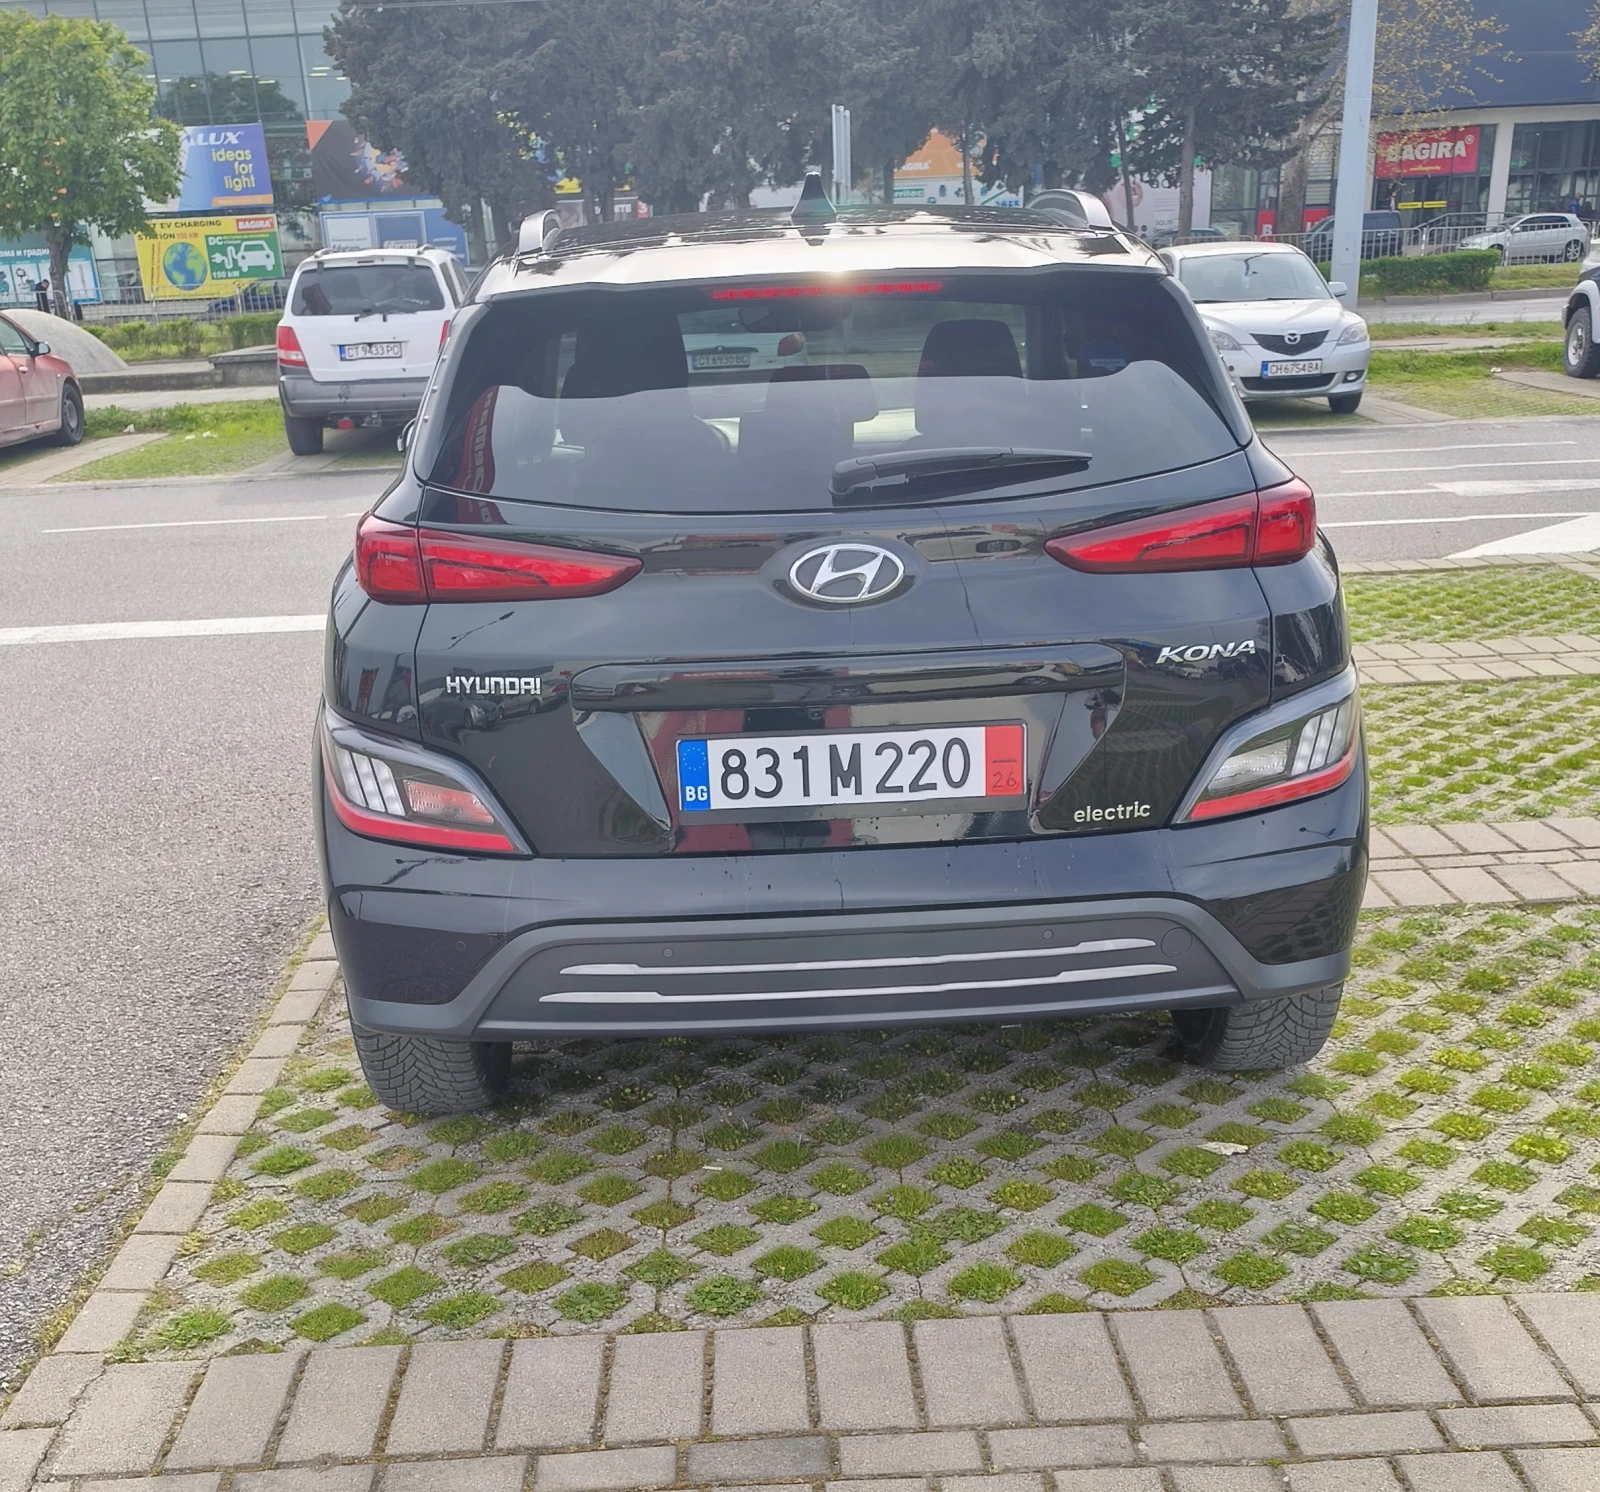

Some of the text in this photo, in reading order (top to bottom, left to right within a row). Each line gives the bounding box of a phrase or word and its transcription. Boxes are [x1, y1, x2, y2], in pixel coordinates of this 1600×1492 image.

[211, 148, 252, 162] ideas
[1386, 141, 1466, 161] BAGIRA
[233, 161, 254, 175] for
[223, 174, 256, 192] light
[160, 222, 172, 230] EV
[174, 219, 222, 229] CHARGING
[238, 219, 272, 230] BAGIRA
[208, 236, 223, 246] DC
[1155, 639, 1257, 665] KONA
[445, 675, 542, 696] HYUNDAI
[992, 772, 1017, 790] 26
[685, 785, 709, 803] BG
[1073, 801, 1151, 823] electric
